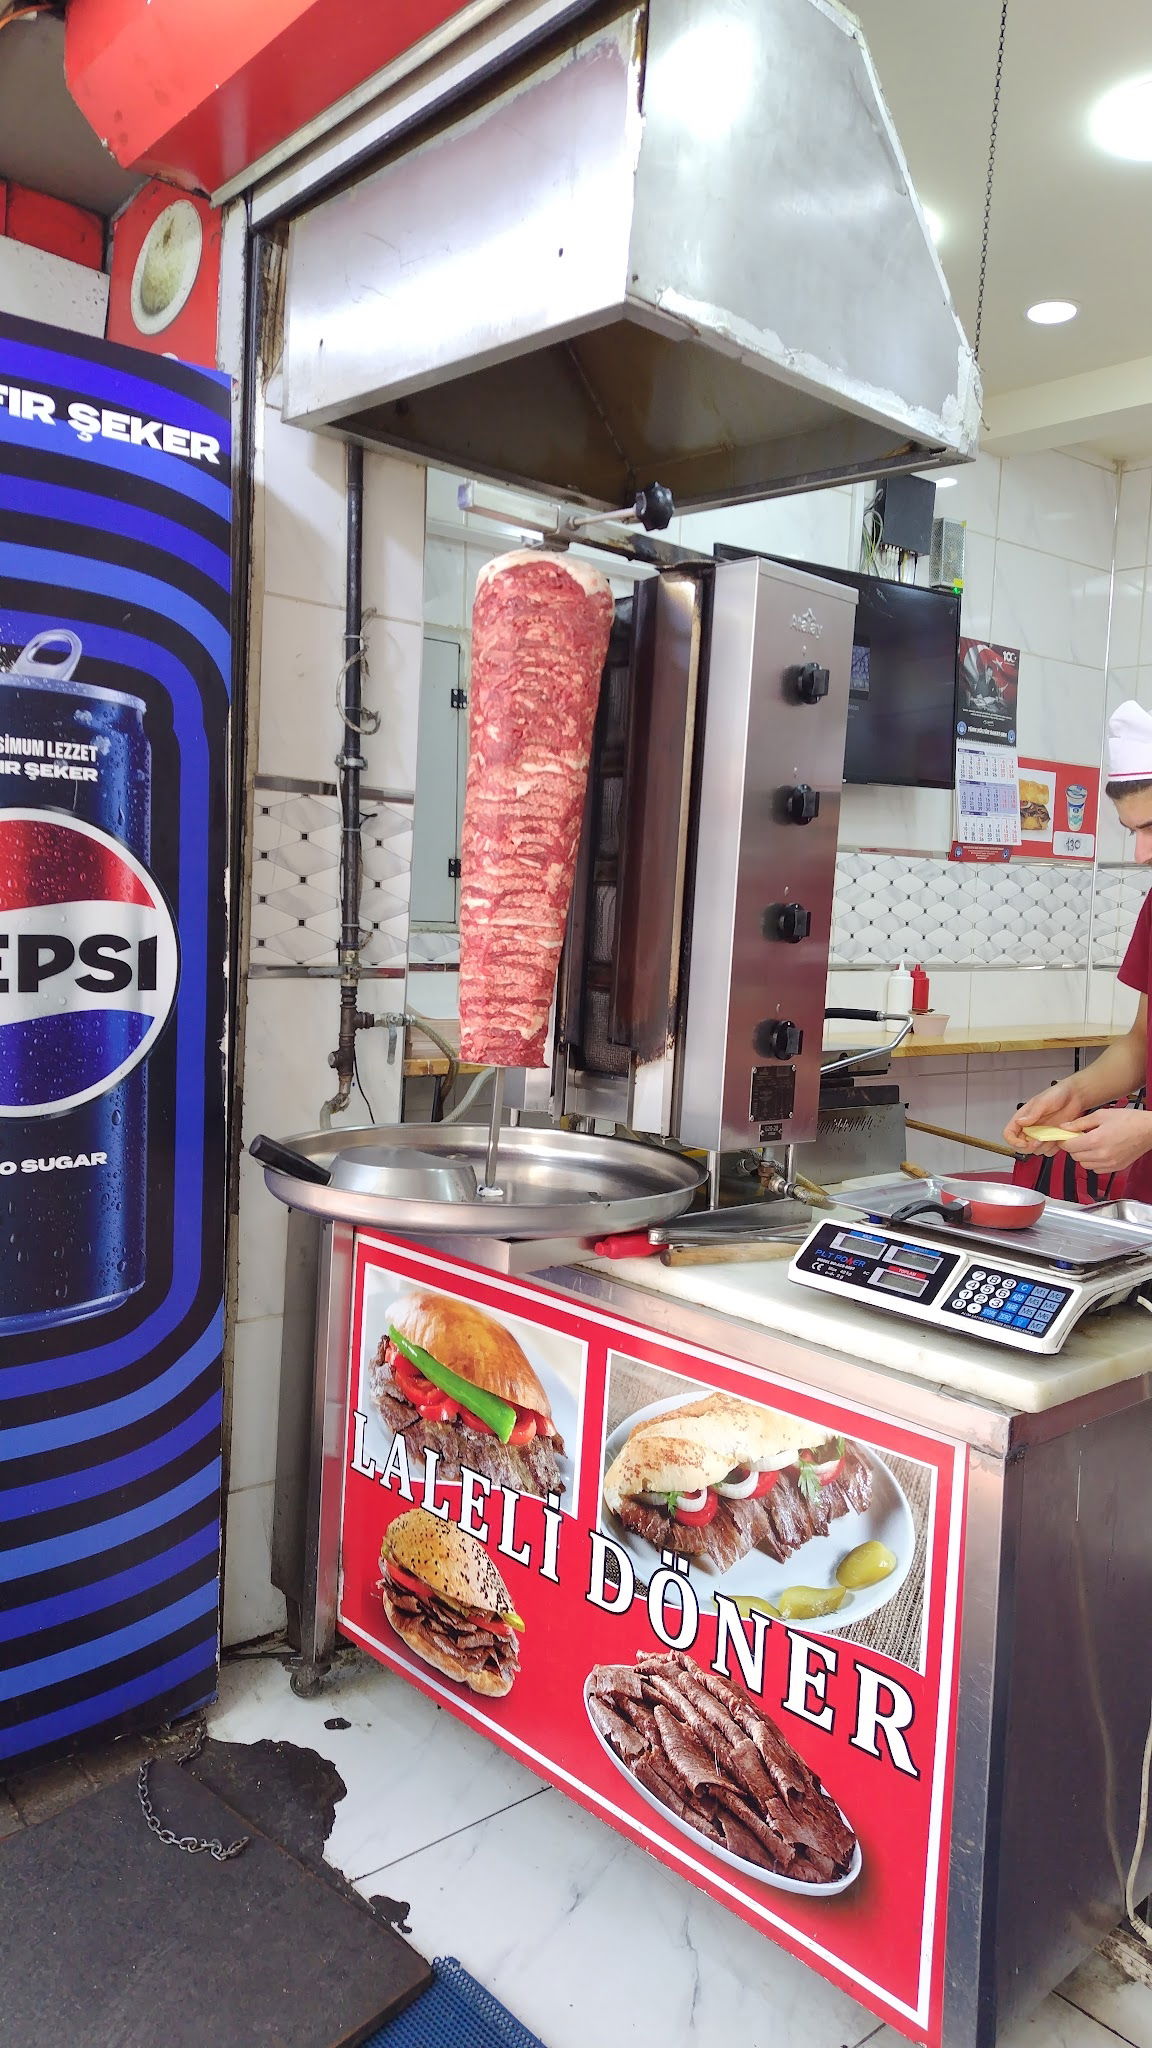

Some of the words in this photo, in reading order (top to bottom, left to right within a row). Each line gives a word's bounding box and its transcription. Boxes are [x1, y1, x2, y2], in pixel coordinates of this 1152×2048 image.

[67, 402, 221, 465] ŞEKER
[46, 740, 98, 762] LEZZET
[24, 762, 98, 782] ŞEKER
[0, 934, 158, 993] PSI
[21, 1151, 108, 1173] SUGAR
[815, 1249, 834, 1258] PLT
[350, 1411, 562, 1584] LALELİ
[585, 1530, 921, 1780] DÖNER
